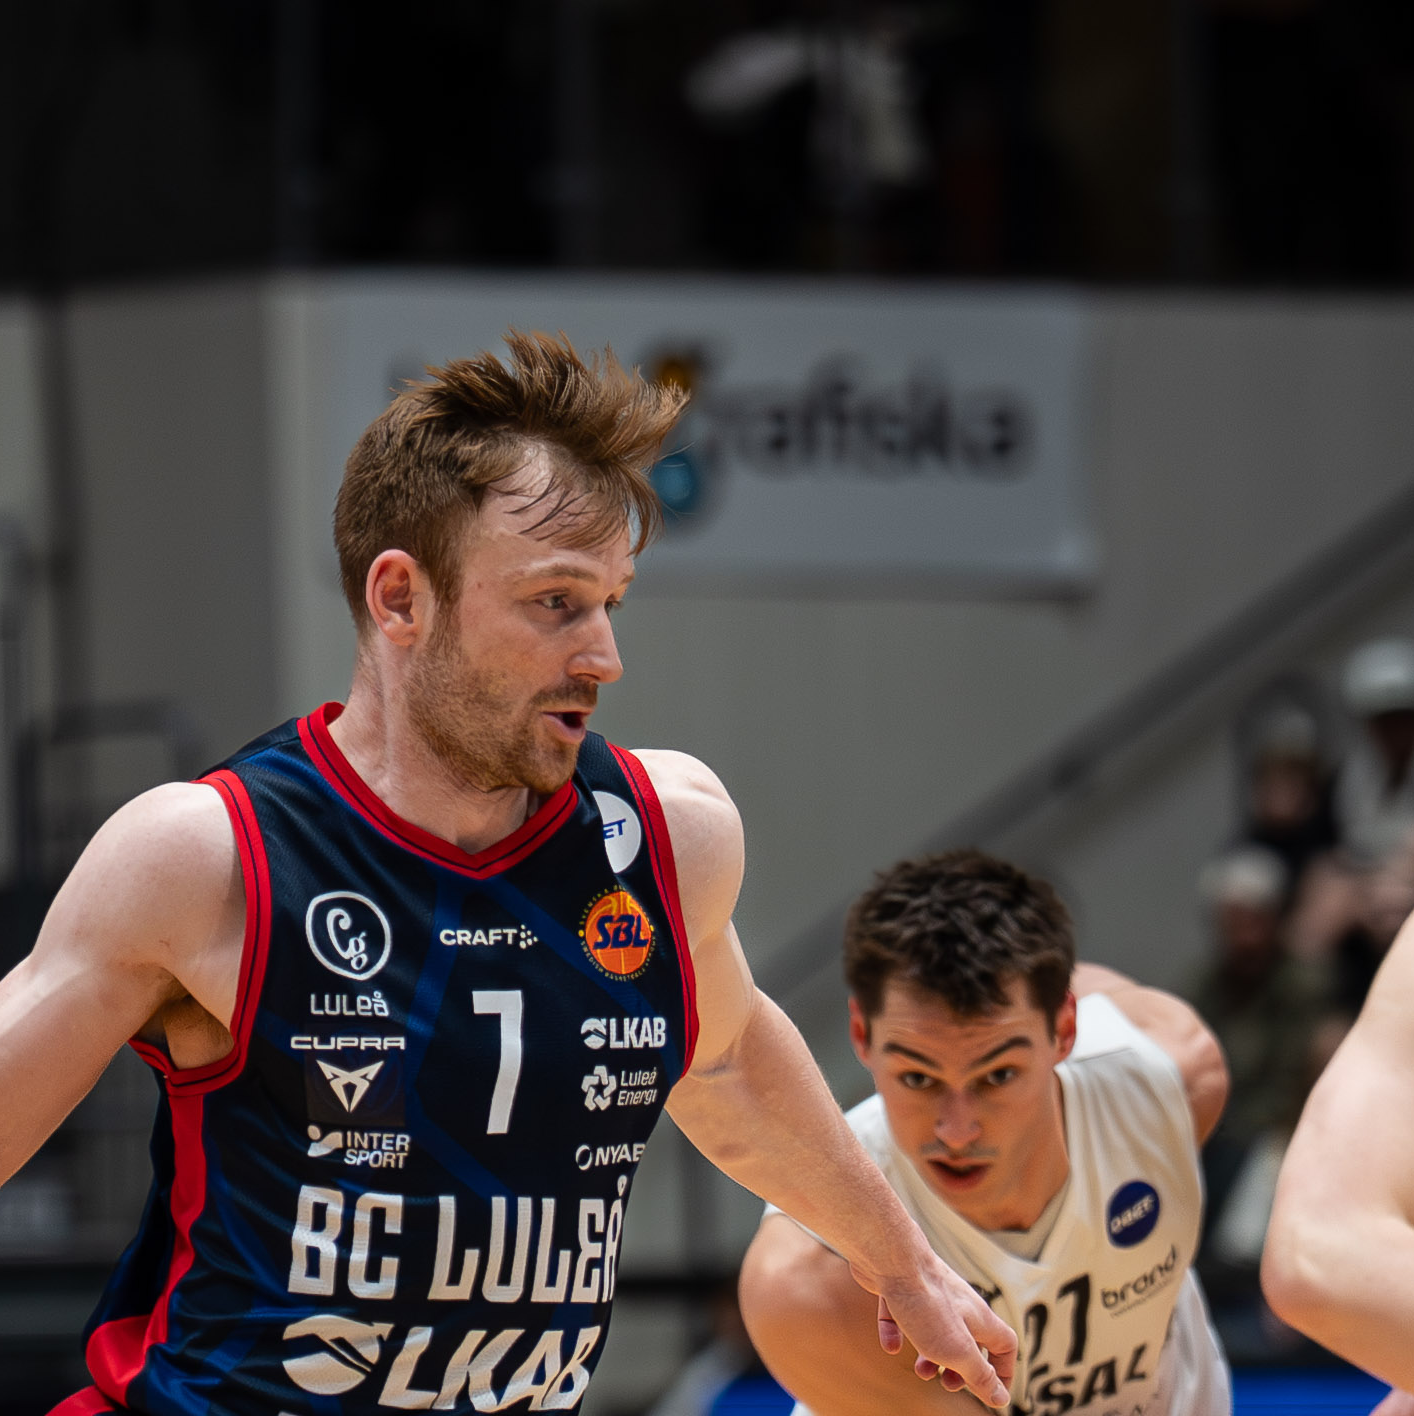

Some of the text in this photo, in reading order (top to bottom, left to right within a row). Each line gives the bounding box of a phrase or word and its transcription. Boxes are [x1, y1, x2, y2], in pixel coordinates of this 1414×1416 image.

[439, 928, 518, 947] CRAFT
[593, 914, 650, 950] SBL
[290, 1036, 406, 1050] CUPRA
[609, 1017, 666, 1049] LKAB
[472, 989, 522, 1134] 7
[620, 1067, 658, 1087] Luleå
[346, 1130, 411, 1152] INTER
[343, 1149, 408, 1169] SPORT
[287, 1184, 404, 1300] BC
[377, 1325, 602, 1413] LKAB
